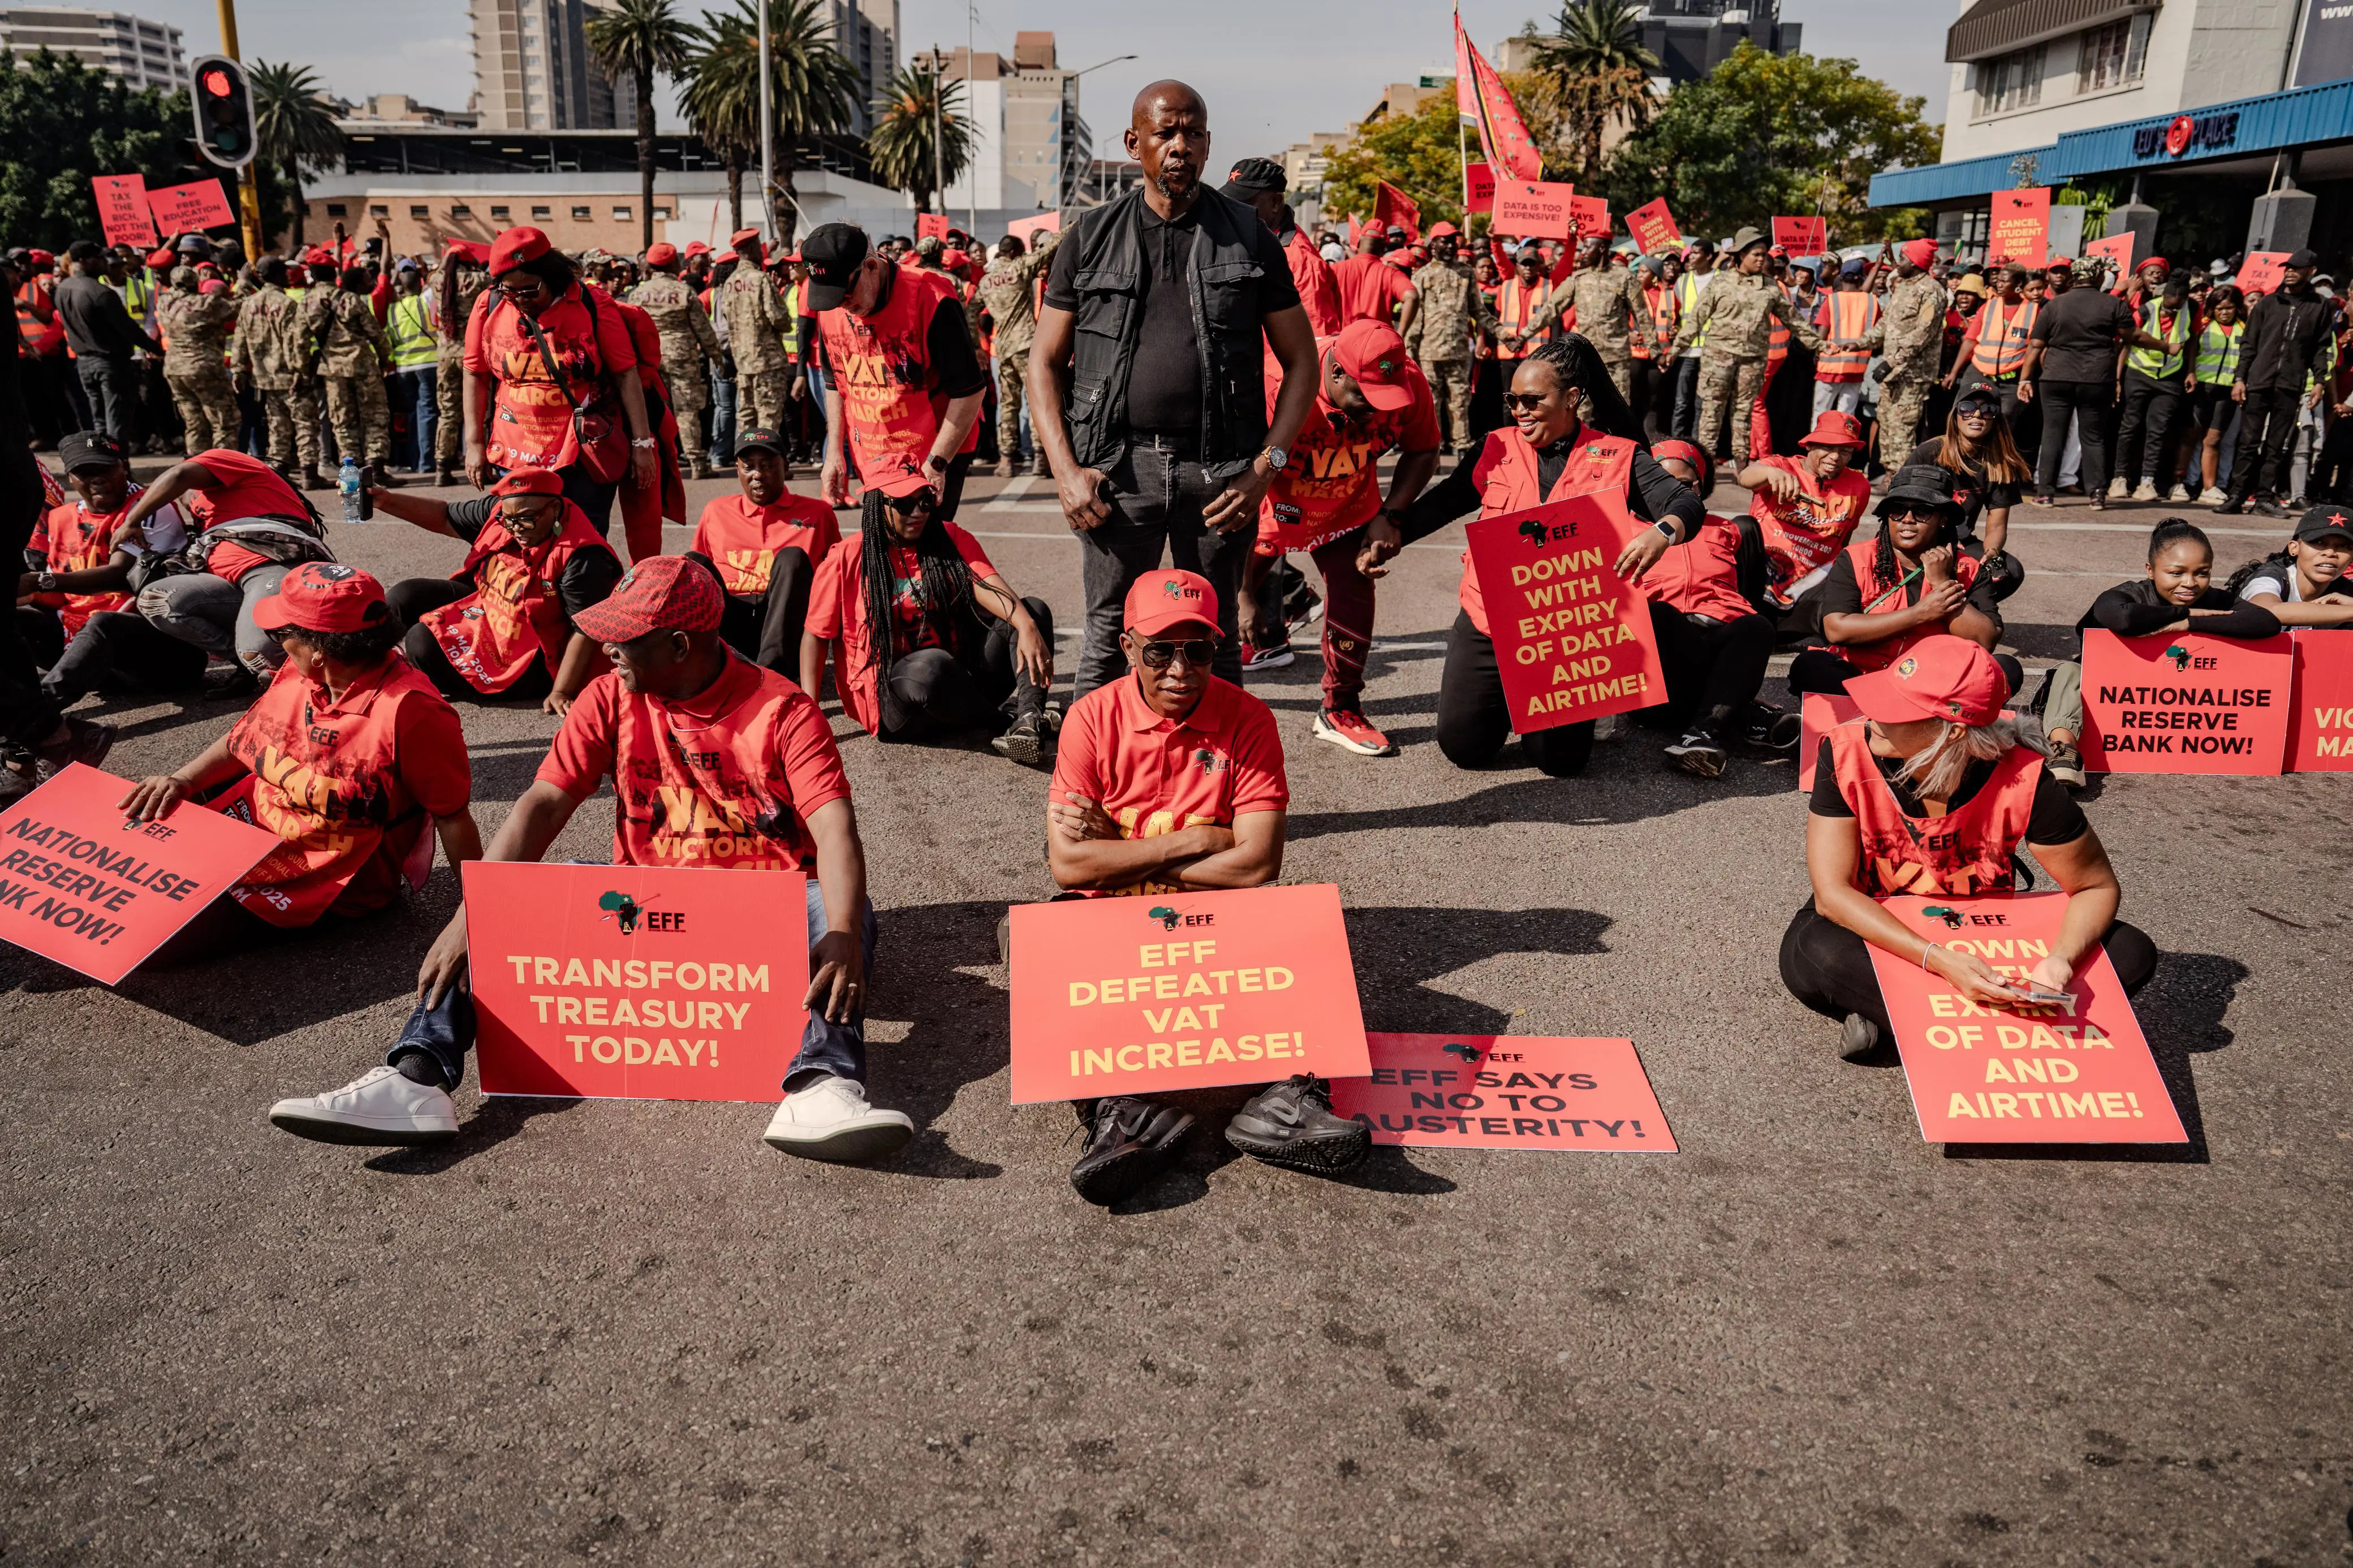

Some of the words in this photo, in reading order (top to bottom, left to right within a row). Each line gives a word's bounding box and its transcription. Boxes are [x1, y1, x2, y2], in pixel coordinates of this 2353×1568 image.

[2191, 114, 2235, 146] PLACE
[163, 204, 221, 222] EDUCATION
[176, 199, 202, 210] FREE
[1503, 202, 1527, 210] DATA
[1531, 203, 1539, 211] IS
[1542, 204, 1562, 213] TOO
[106, 224, 128, 232] NOT
[130, 222, 150, 231] THE
[182, 216, 210, 227] NOW!
[1503, 211, 1560, 222] EXPENSIVE!
[1640, 215, 1663, 233] DOWN
[1999, 218, 2040, 228] CANCEL
[114, 231, 147, 242] POOR!
[1644, 224, 1664, 238] WITH
[1645, 228, 1669, 248] EXPIRY
[1996, 227, 2043, 238] STUDENT
[2003, 247, 2032, 256] NOW!
[2005, 238, 2032, 247] DEBT
[2251, 270, 2271, 279] TAX
[505, 352, 563, 380] VAT
[842, 352, 886, 385] VAT
[890, 436, 924, 450] TREASURY
[520, 451, 546, 463] MAY
[1312, 442, 1371, 478] VAT
[1290, 480, 1358, 499] MARC
[1274, 513, 1287, 522] TO:
[1276, 503, 1301, 515] FROM:
[1788, 507, 1849, 525] Against
[1552, 522, 1578, 539] EFF
[1774, 529, 1783, 537] 27
[1785, 532, 1818, 550] NOVEMBER
[727, 550, 774, 572] VA
[1792, 543, 1813, 558] 10H00
[1511, 546, 1603, 586] DOWN
[1184, 589, 1201, 600] EFF
[1524, 574, 1602, 609] WITH
[1518, 598, 1618, 639] EXPIRY
[446, 624, 459, 635] 19
[456, 635, 476, 658] MAY
[470, 658, 494, 685] 2025
[1516, 640, 1553, 665] OF
[1561, 623, 1636, 656] DATA
[447, 645, 472, 673] 10AM
[2194, 658, 2217, 668] EFF
[1552, 655, 1611, 685] AND
[1527, 672, 1648, 716] AIRTIME!
[2100, 686, 2272, 707] NATIONALISE
[1962, 710, 1976, 719] EFF
[2122, 711, 2238, 730] RESERVE
[310, 726, 339, 746] EFF
[2102, 734, 2174, 753] BANK
[2181, 736, 2253, 755] NOW!
[689, 752, 721, 770] EFF
[1217, 759, 1231, 771] EF
[264, 745, 340, 815] VAT
[658, 786, 745, 833] VAT
[144, 822, 178, 839] EFF
[1928, 828, 1962, 852] EFF
[652, 836, 764, 859] VICTORY
[6, 818, 200, 901] NATIONALISE
[0, 848, 137, 912] RESERVE
[1875, 856, 1978, 896] VAT
[29, 897, 126, 945] NOW!
[648, 912, 686, 930] EFF
[1186, 914, 1214, 926] EFF
[1970, 914, 2008, 925] EFF
[1140, 940, 1216, 968] EFF
[1940, 939, 2050, 958] OWN
[507, 955, 769, 992] TRANSFORM
[1069, 966, 1294, 1007] DEFEATED
[530, 995, 751, 1030] TREASURY
[1141, 1003, 1225, 1034] VAT
[1925, 1025, 1984, 1049] OF
[1996, 1025, 2115, 1049] DATA
[566, 1035, 719, 1068] TODAY!
[1070, 1031, 1305, 1077] INCREASE!
[1489, 1053, 1525, 1062] EFF
[1371, 1068, 1458, 1086] EFF
[1475, 1072, 1597, 1090] SAYS
[1985, 1058, 2079, 1083] AND
[1411, 1091, 1484, 1110] NO
[1498, 1094, 1566, 1112] TO
[1947, 1092, 2144, 1118] AIRTIME!
[1352, 1113, 1647, 1138] AUSTERITY!
